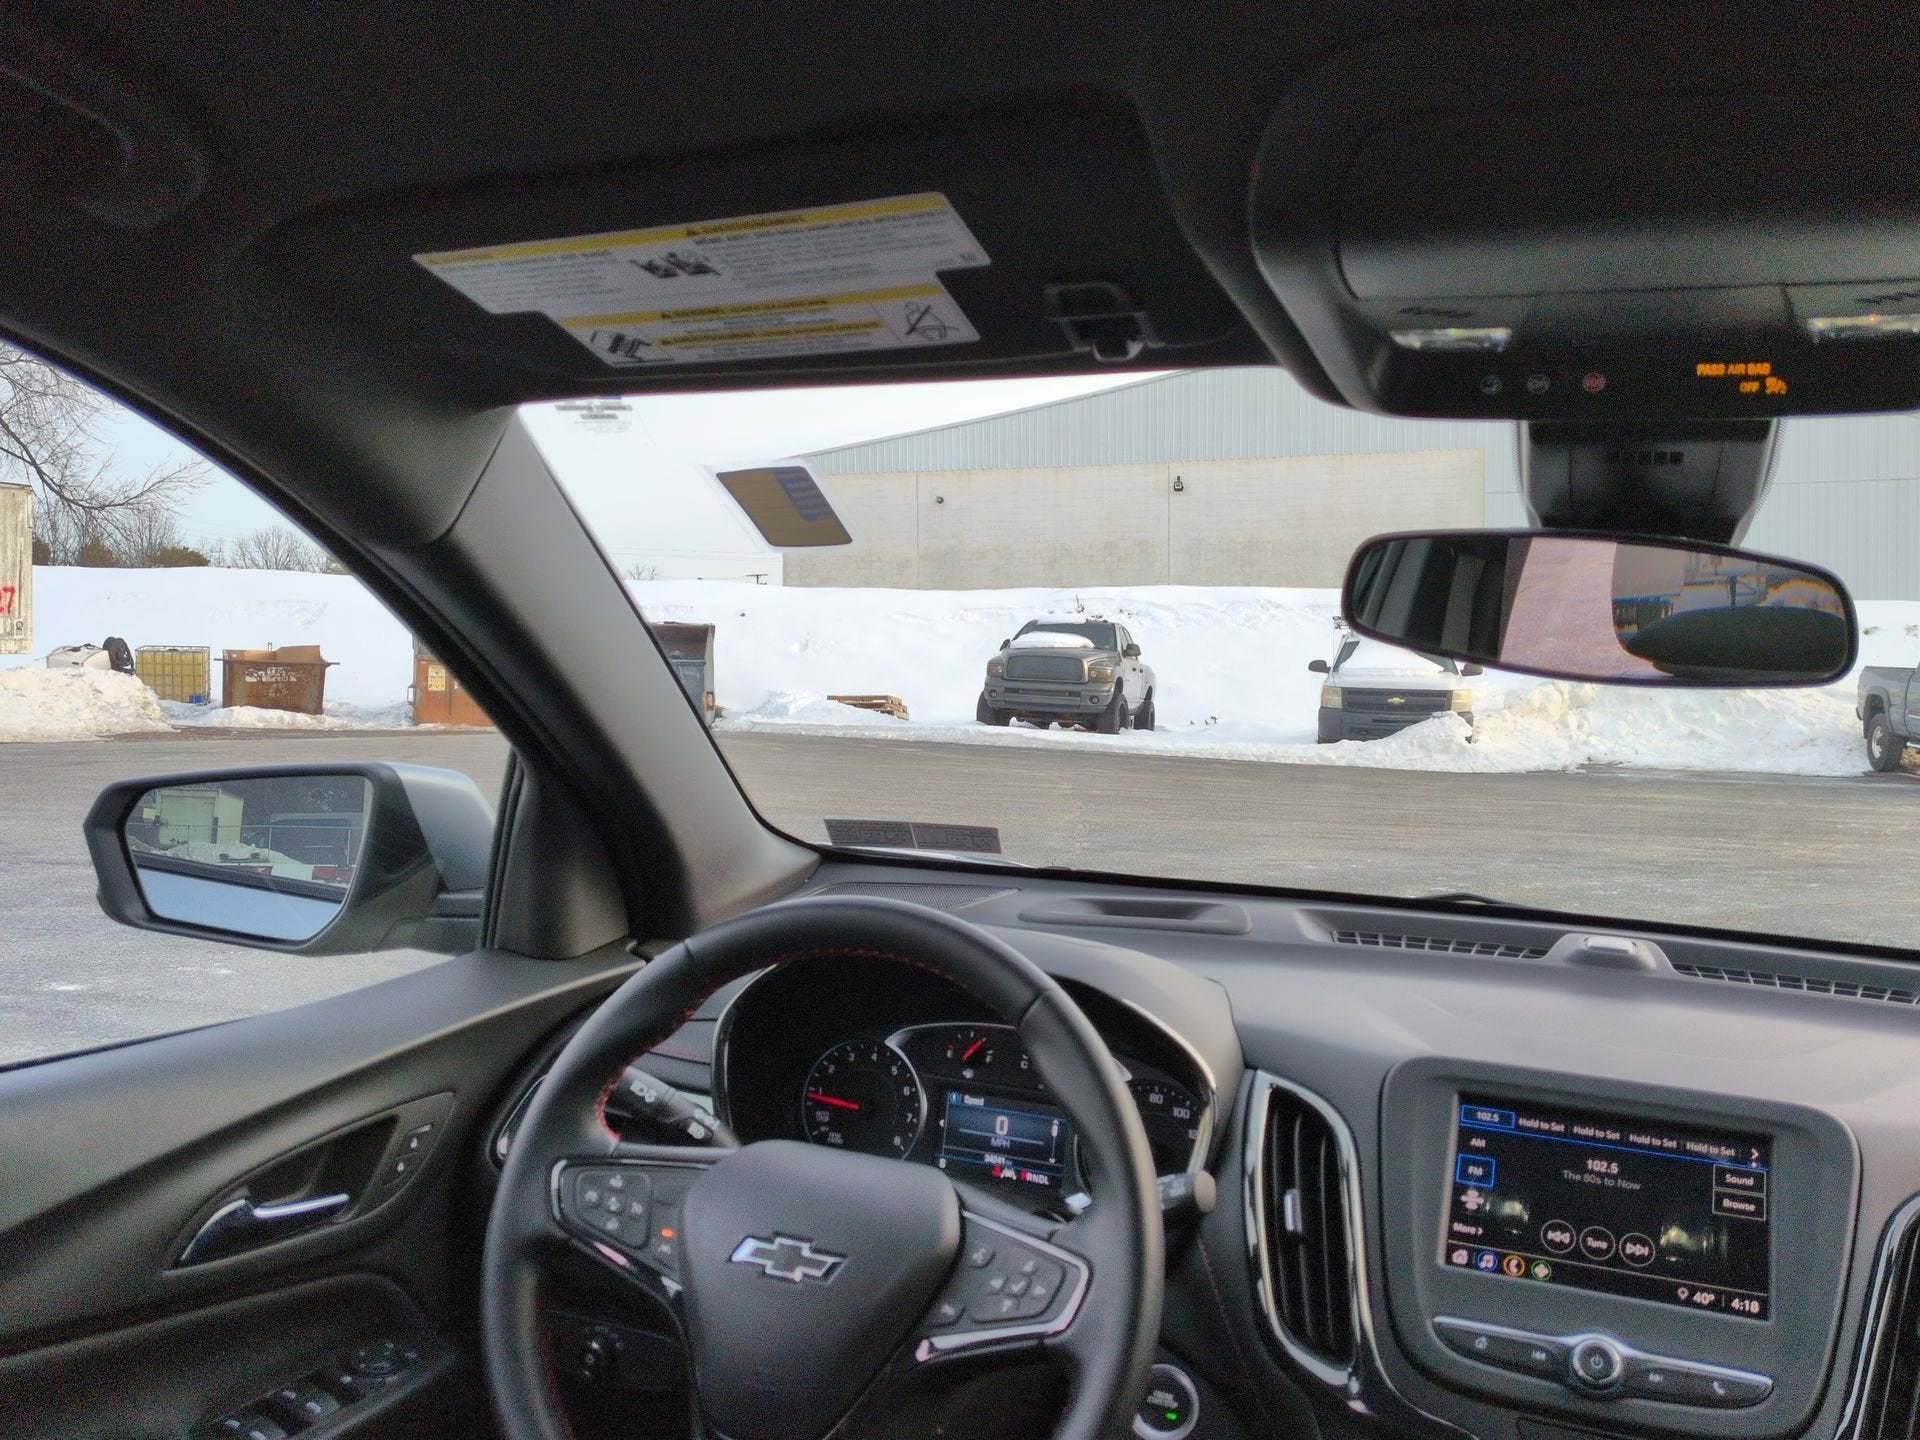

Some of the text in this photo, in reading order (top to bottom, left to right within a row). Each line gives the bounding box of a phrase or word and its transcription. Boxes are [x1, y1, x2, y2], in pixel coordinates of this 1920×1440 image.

[0, 586, 16, 615] 7
[1172, 1106, 1191, 1119] 100
[995, 1115, 1009, 1136] 0
[1519, 1117, 1565, 1133] Hold to Set
[1573, 1125, 1620, 1141] Hold to Set
[1188, 1128, 1199, 1140] 12
[1629, 1133, 1677, 1149] Hold to Set
[1470, 1138, 1486, 1149] AM
[1686, 1141, 1736, 1157] Hold to Set
[1468, 1165, 1483, 1177] FM
[1586, 1159, 1619, 1175] 102.5
[1563, 1169, 1581, 1181] The
[1604, 1177, 1616, 1187] to
[1617, 1178, 1641, 1190] Now
[1725, 1173, 1754, 1186] Sound
[1722, 1198, 1756, 1212] Browse
[1453, 1222, 1476, 1235] More
[1586, 1237, 1608, 1250] Tune
[1731, 1298, 1760, 1314] 4:18
